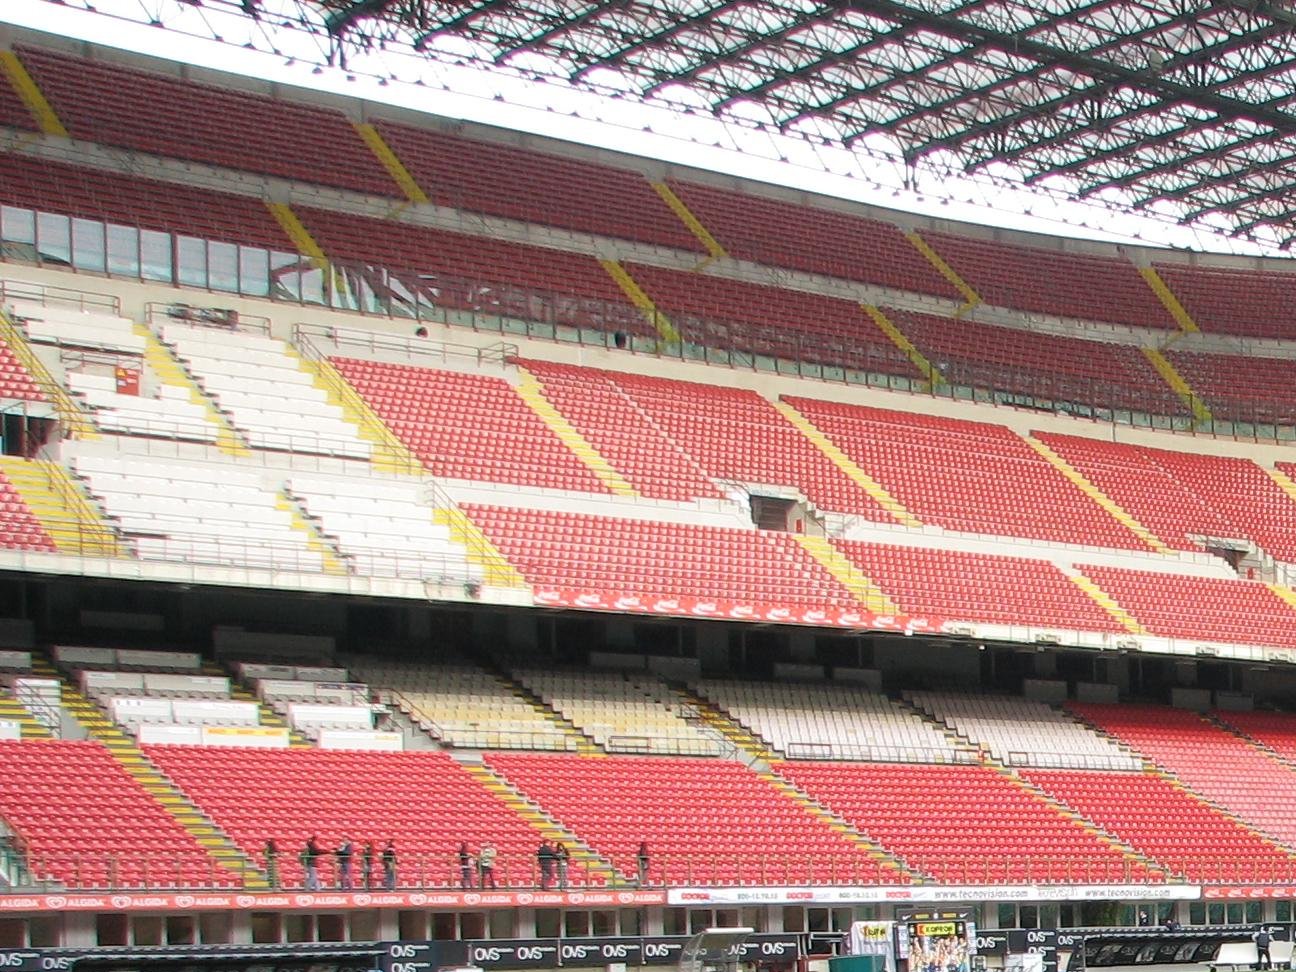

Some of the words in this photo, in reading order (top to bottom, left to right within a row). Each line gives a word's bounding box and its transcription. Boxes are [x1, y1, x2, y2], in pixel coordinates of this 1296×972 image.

[977, 936, 996, 948] OVS
[1027, 931, 1045, 942] OVS
[1058, 935, 1074, 945] OVS
[391, 944, 416, 958] OVS
[474, 947, 500, 961] OVS
[517, 946, 543, 960] OVS
[562, 945, 587, 958] OVS
[603, 944, 627, 957] OVS
[646, 943, 669, 957] OVS
[762, 942, 785, 955] OVS
[42, 956, 69, 970] OVS
